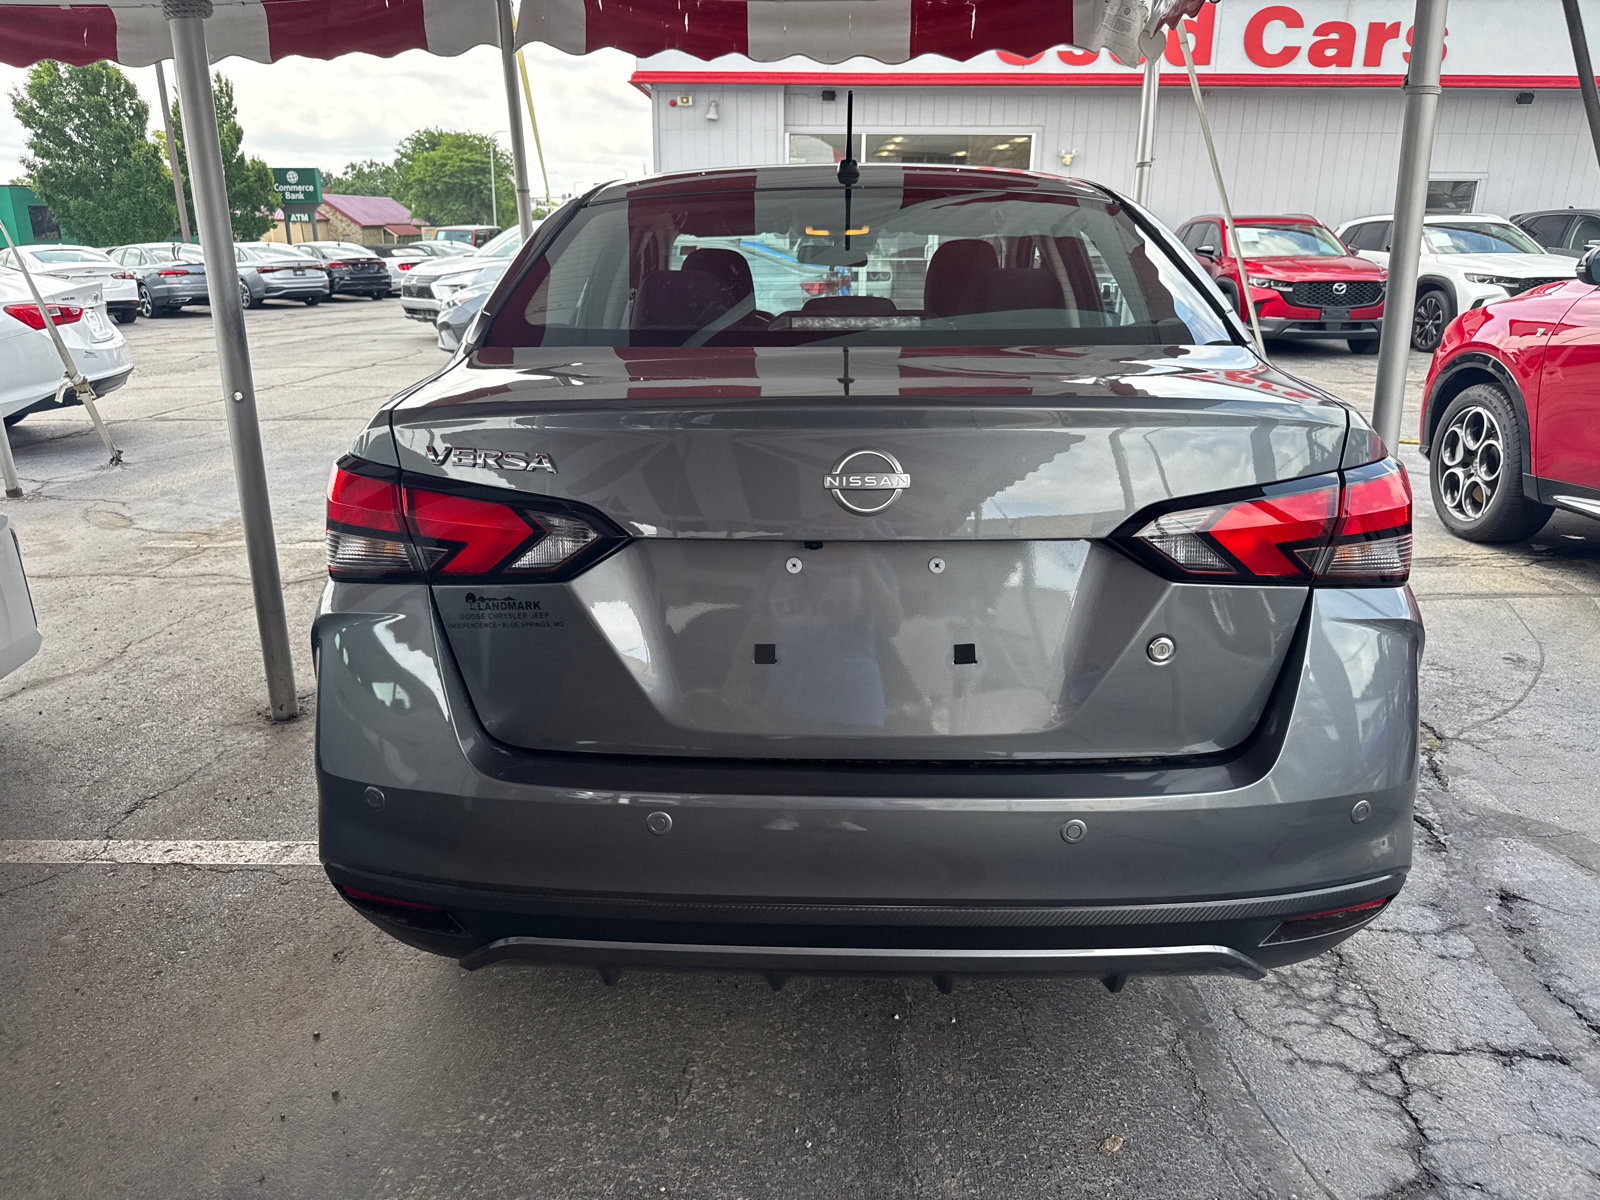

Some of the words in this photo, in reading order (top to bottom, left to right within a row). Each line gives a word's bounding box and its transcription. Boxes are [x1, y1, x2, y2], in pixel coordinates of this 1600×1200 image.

[273, 183, 314, 192] Commerce
[285, 191, 304, 200] Bank
[290, 213, 309, 222] ATM
[426, 445, 558, 474] VERSA
[826, 476, 907, 487] NISSAN
[478, 601, 541, 611] LANDMARK
[459, 612, 486, 620] DODGE
[488, 612, 527, 620] CHRYSLER
[531, 611, 550, 619] JEEP
